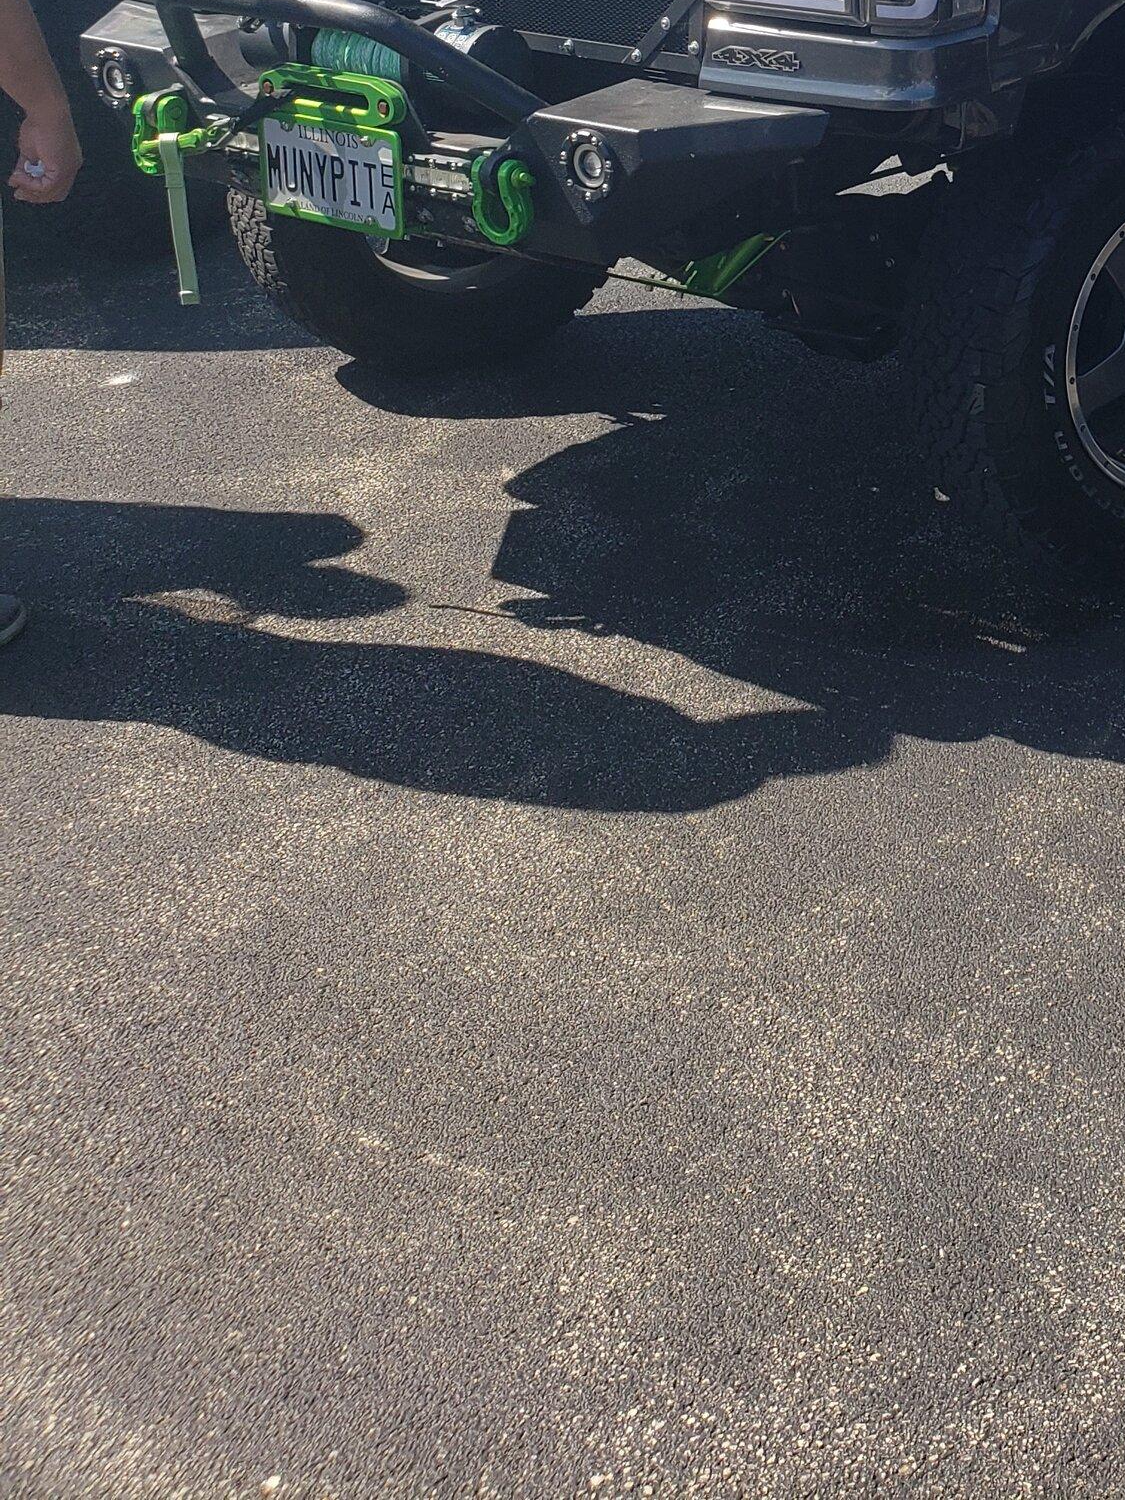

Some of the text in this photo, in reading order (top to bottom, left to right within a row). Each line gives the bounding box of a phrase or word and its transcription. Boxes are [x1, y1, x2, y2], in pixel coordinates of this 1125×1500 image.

[298, 124, 360, 149] ILLINOIS
[267, 143, 377, 210] MUNYPIT
[300, 201, 364, 222] LAND OF LINCOLN
